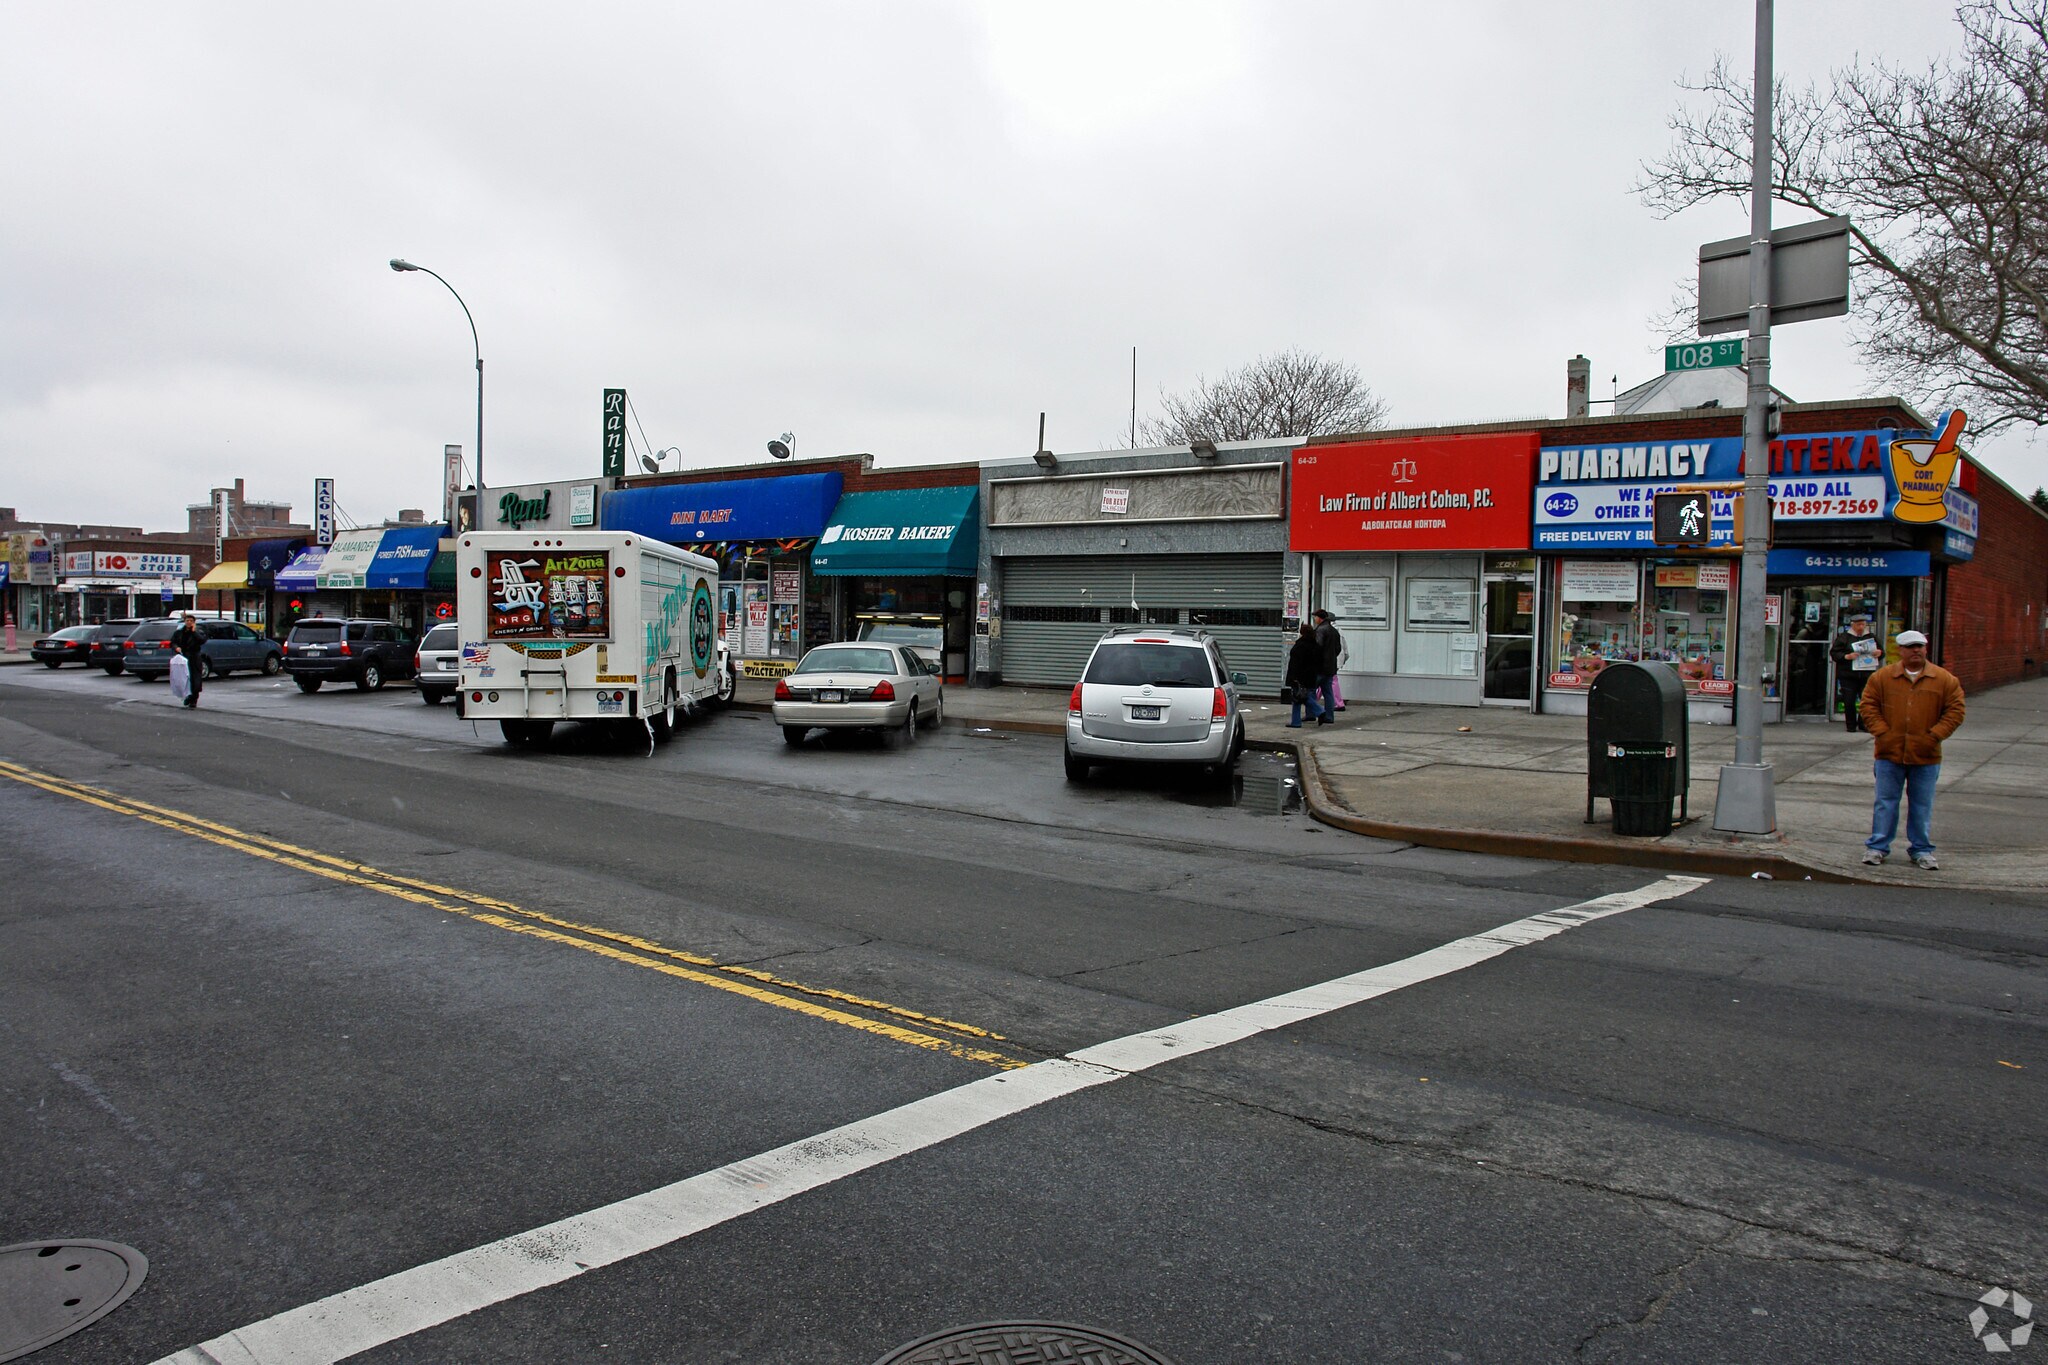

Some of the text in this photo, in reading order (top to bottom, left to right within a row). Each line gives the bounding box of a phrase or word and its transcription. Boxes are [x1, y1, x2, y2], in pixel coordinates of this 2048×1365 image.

[1674, 343, 1735, 369] 108 ST
[605, 392, 623, 468] Rani
[1298, 456, 1317, 465] 64-23
[1540, 444, 1711, 482] PHARMACY
[1914, 470, 1934, 480] CORT
[1783, 481, 1818, 497] AND
[1823, 481, 1852, 496] ALL
[1903, 481, 1944, 492] PHARMACY
[1103, 497, 1127, 506] FOR RENT
[1320, 488, 1495, 512] Law Firm of Albert Cohen, P.C.
[1618, 488, 1641, 502] WE
[319, 481, 330, 543] TACO KING
[497, 489, 552, 529] Rani
[1545, 499, 1577, 511] 64-25
[670, 508, 732, 525] MINI MART
[1595, 505, 1640, 520] OTHER
[1361, 518, 1447, 531] АДВОКАТСКАЯ КОНТОРА
[841, 525, 956, 541] KOSHER BAKERY
[1540, 531, 1569, 542] FREE
[1571, 530, 1631, 541] DELIVERY
[394, 545, 413, 559] FISH
[141, 555, 182, 564] SMILE
[544, 554, 605, 575] AriZona
[1805, 556, 1888, 568] 64-25 108 St.
[140, 563, 182, 572] STORE
